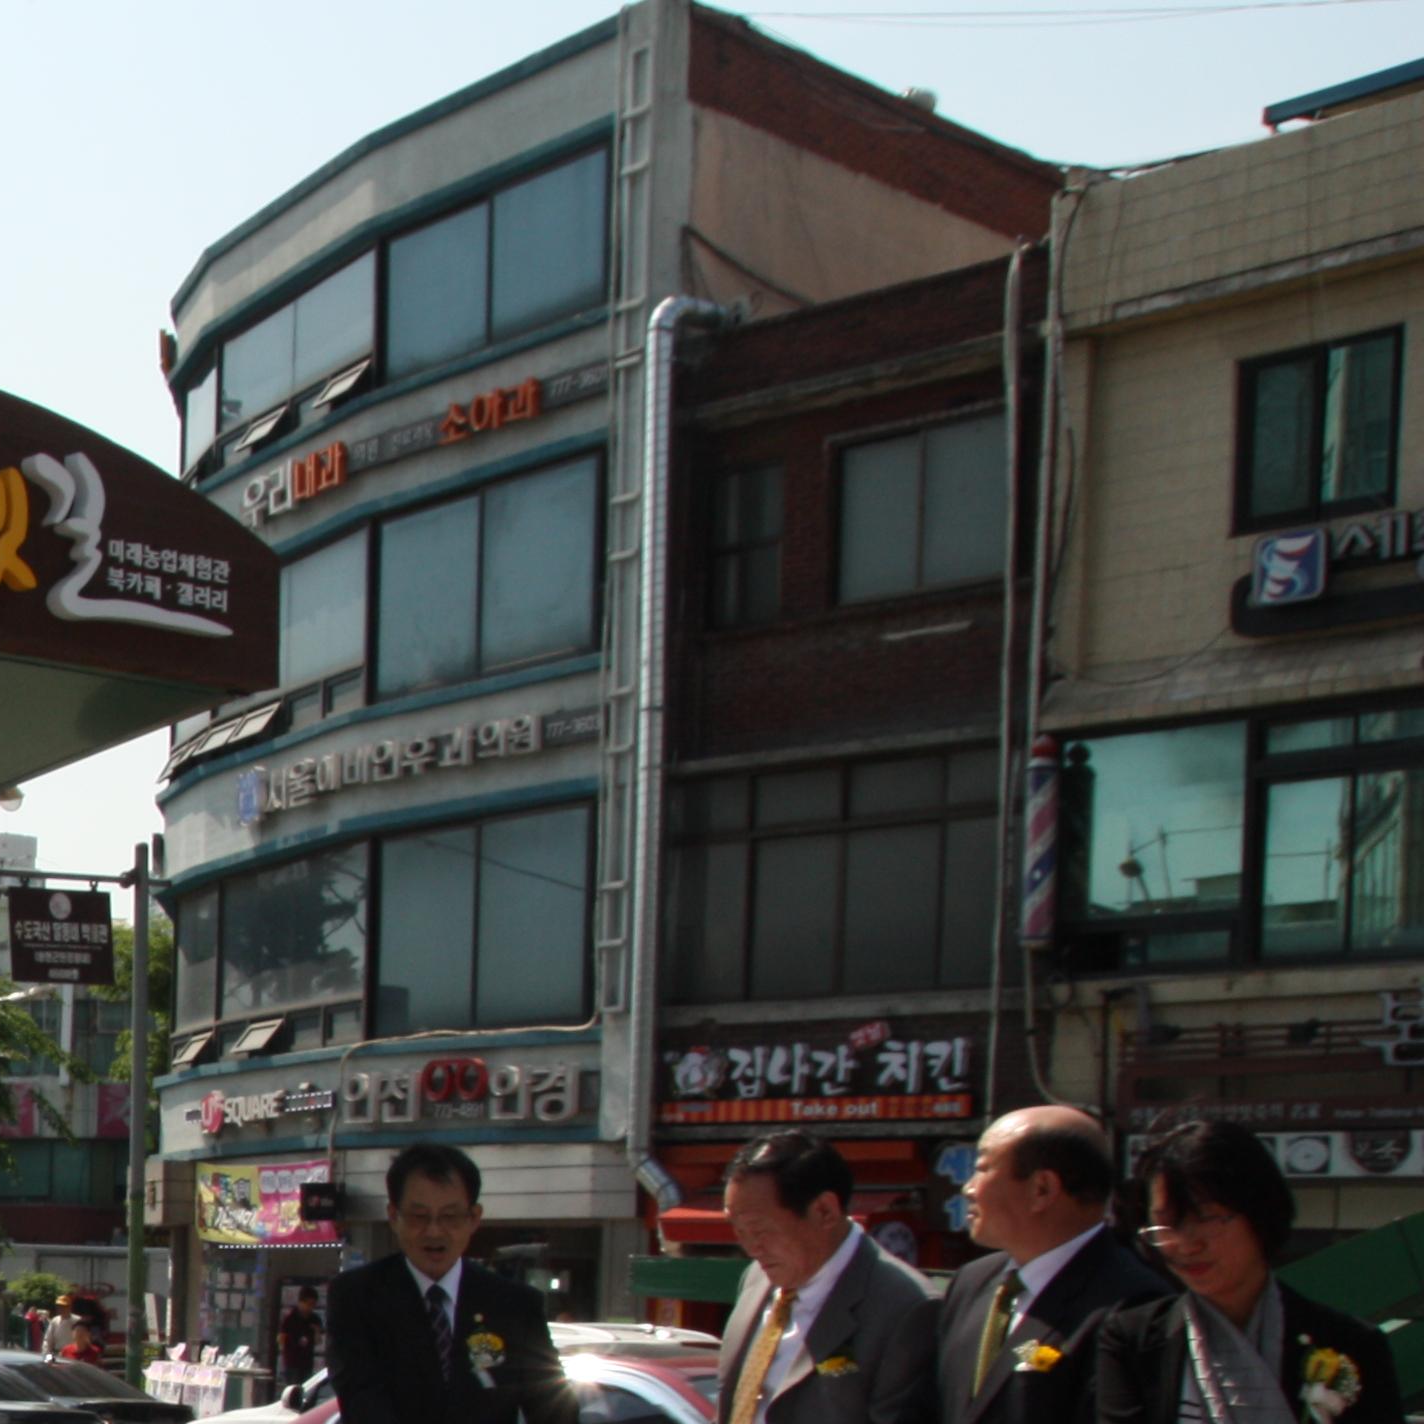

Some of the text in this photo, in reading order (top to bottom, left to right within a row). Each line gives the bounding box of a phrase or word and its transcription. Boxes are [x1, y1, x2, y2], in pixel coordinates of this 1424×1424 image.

[437, 377, 542, 445] 소아과
[108, 539, 231, 584] 미래농업체험관
[489, 1063, 580, 1122] 안경
[728, 1037, 971, 1099] 집나간 치킨
[224, 1090, 285, 1127] SQUARE
[791, 1101, 879, 1116] Take out
